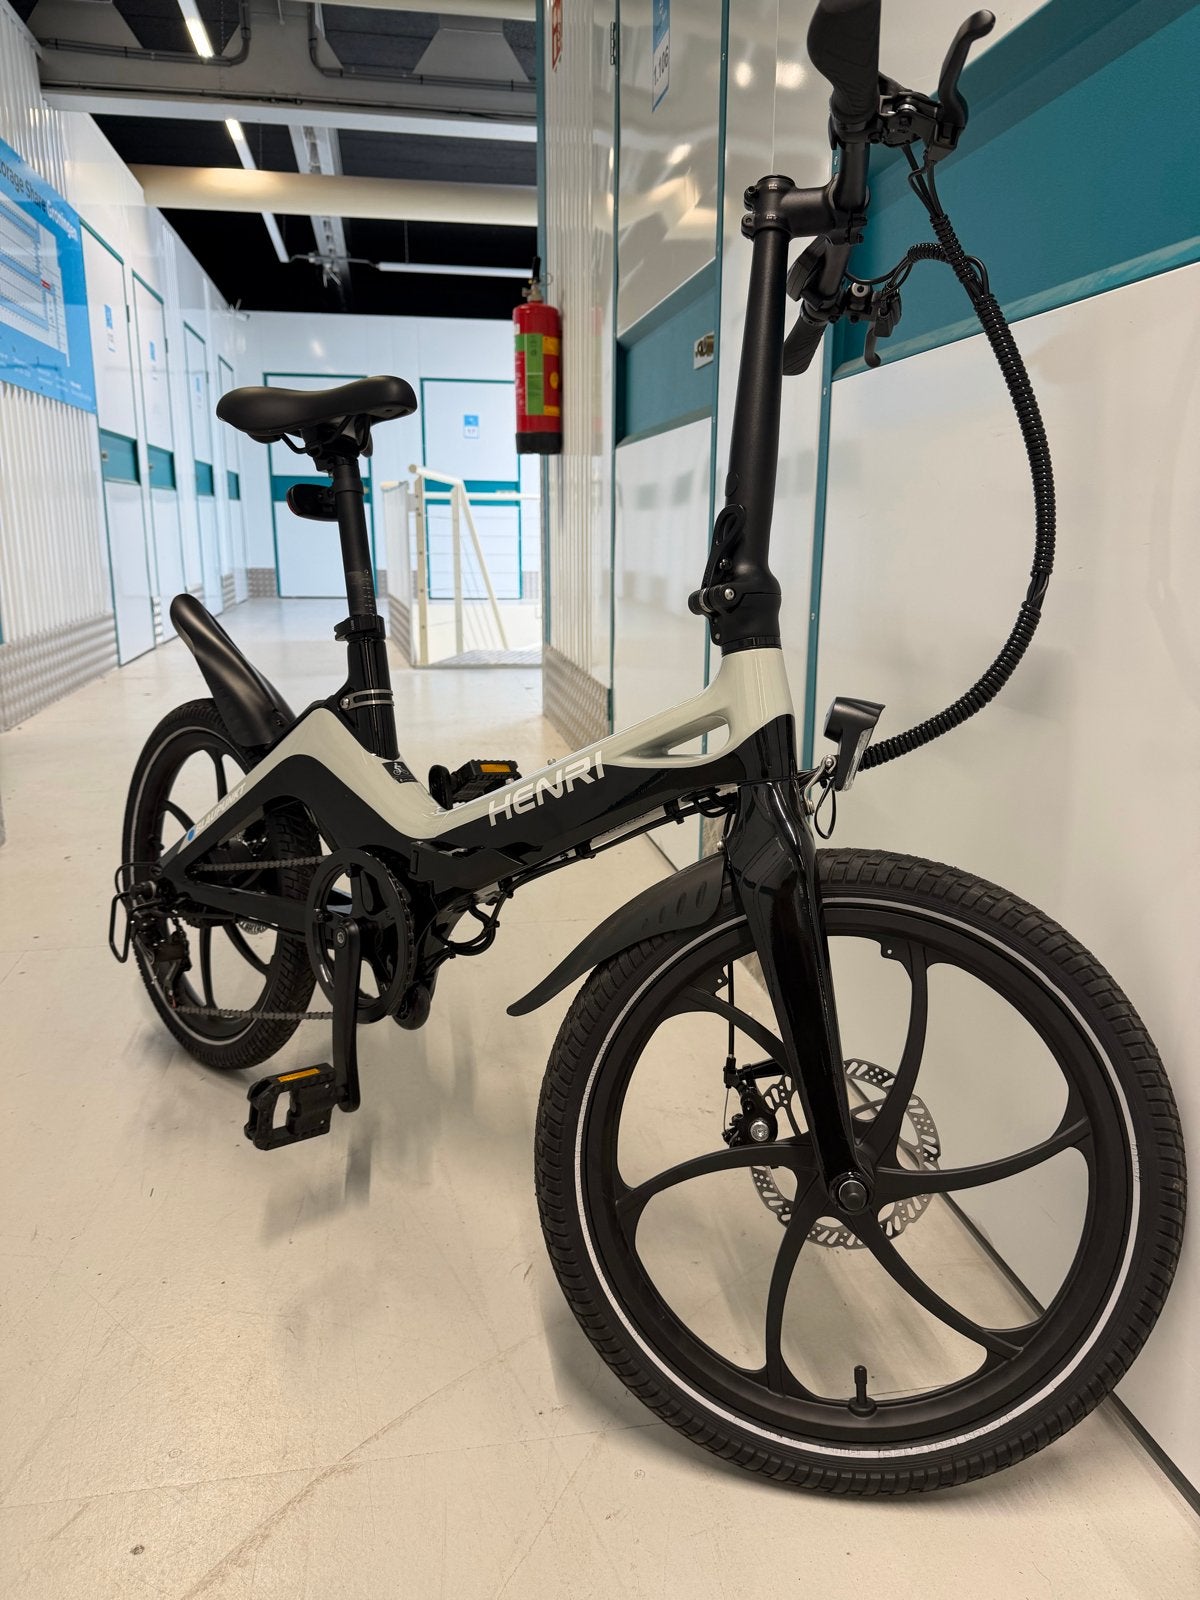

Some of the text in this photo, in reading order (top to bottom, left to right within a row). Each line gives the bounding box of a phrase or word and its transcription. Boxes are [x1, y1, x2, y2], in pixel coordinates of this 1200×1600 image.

[0, 161, 25, 193] orage
[25, 180, 47, 212] Share
[488, 750, 605, 827] HENRI
